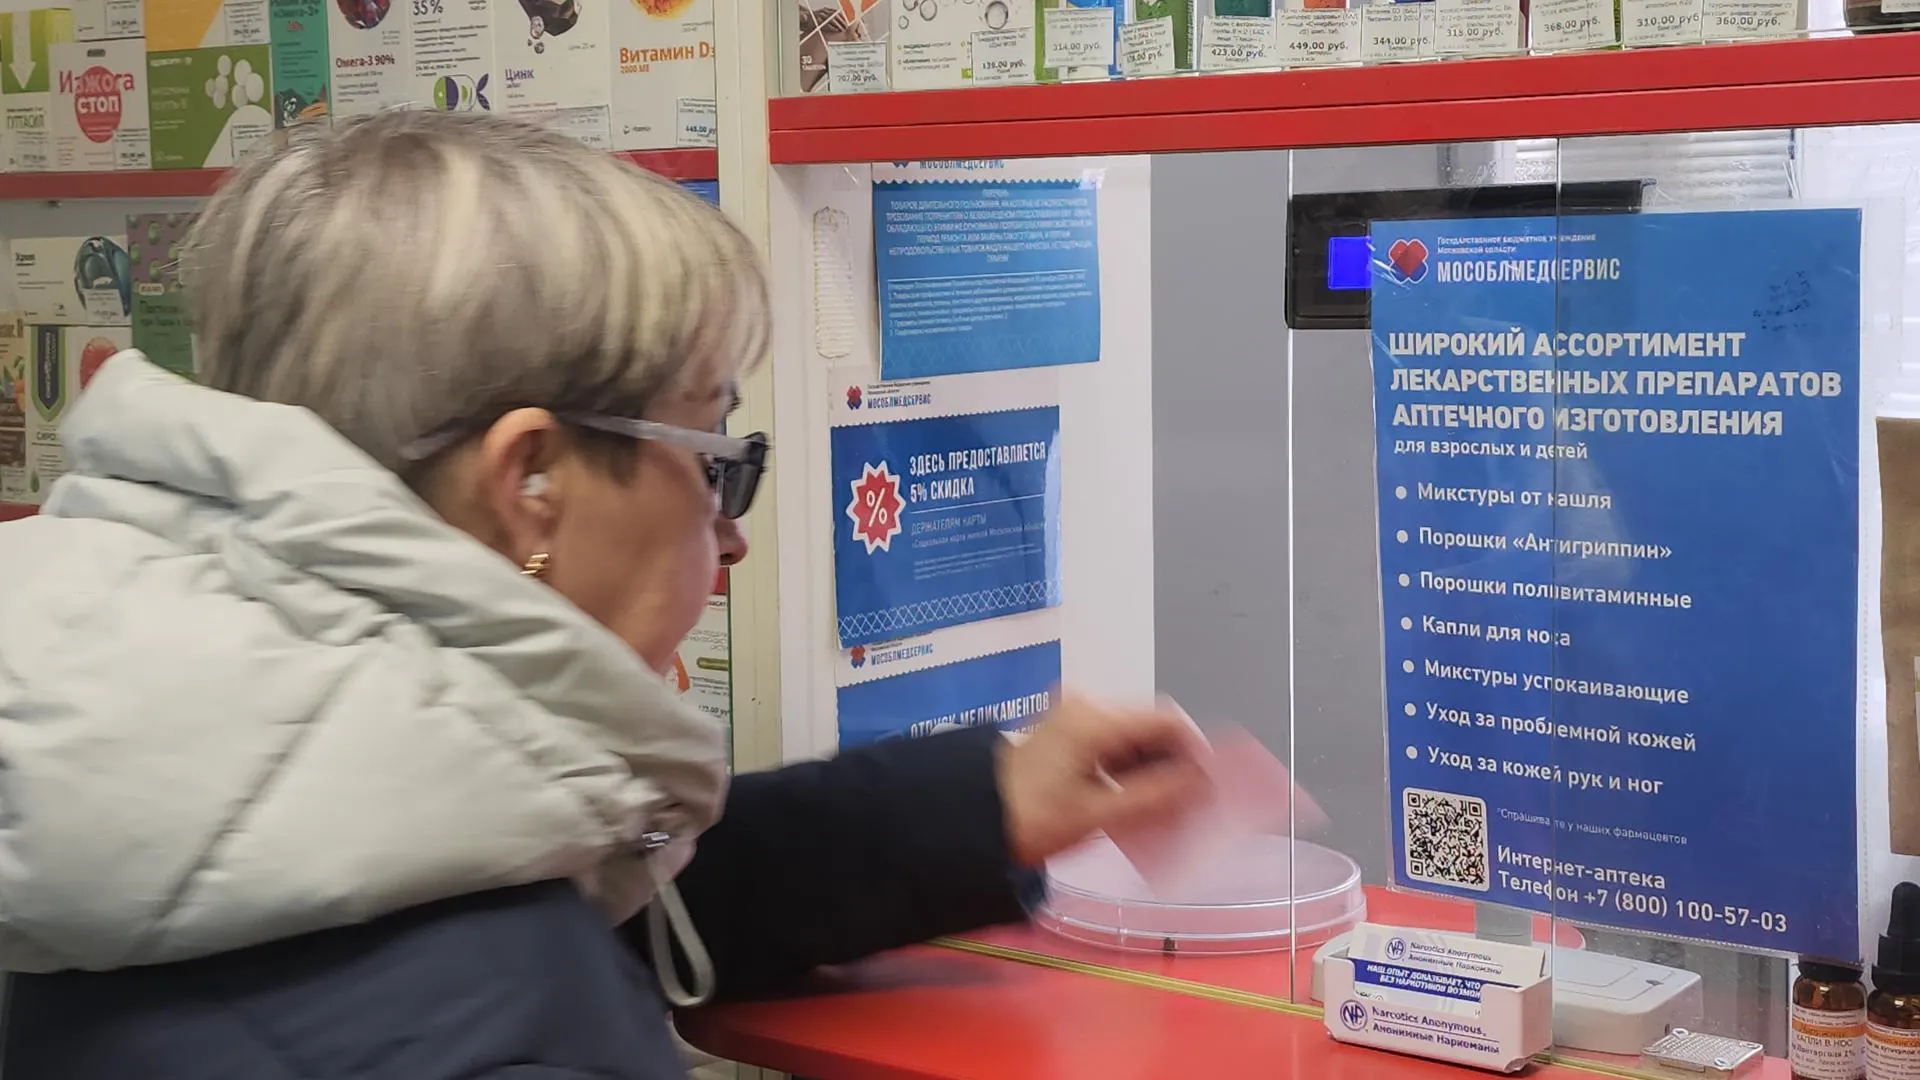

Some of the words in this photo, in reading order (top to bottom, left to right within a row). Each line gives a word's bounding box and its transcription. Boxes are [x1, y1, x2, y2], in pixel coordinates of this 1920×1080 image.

[1636, 15, 1675, 27] 310.00
[1716, 16, 1754, 26] 360.00
[1757, 16, 1781, 28] руб.
[620, 46, 694, 64] Витамин
[1211, 48, 1243, 57] 423.00
[1289, 41, 1325, 50] 449.00
[1328, 41, 1349, 52] руб.
[505, 68, 534, 82] Цинк
[1437, 258, 1620, 284] МОСОБЛМЕДСЕРВИС
[1389, 326, 1525, 357] ШИРОКИЙ
[1532, 332, 1746, 357] АССОРТИМЕНТ
[1390, 368, 1628, 395] ЛЕКАРСТВЕННЫХ
[1636, 371, 1842, 397] ПРЕПАРАТОВ
[867, 393, 932, 409] МОСОБЛМЕДСЕРВИС
[1392, 404, 1545, 430] АПТЕЧНОГО
[1553, 408, 1783, 436] ИЗГОТОВЛЕНИЯ
[909, 453, 944, 477] ЗДЕСЬ
[949, 441, 1046, 471] ПРЕДОСТАВЛЯЕТСЯ
[1394, 440, 1425, 455] для
[1430, 441, 1516, 460] взрослых
[1520, 444, 1531, 457] и
[1535, 442, 1588, 460] детей
[910, 484, 928, 502] 5%
[930, 477, 975, 501] СКИДКА
[1417, 482, 1515, 506] Микстуры
[1520, 490, 1543, 506] от
[1419, 526, 1506, 550] Порошки
[1419, 571, 1506, 594] Порошки
[1512, 584, 1692, 609] поливитаминные
[1422, 616, 1481, 638] Капли
[1486, 624, 1521, 642] для
[1424, 658, 1518, 688] Микстуры
[1523, 673, 1690, 704] успокаивающие
[1425, 702, 1471, 728] Уход
[1475, 712, 1495, 728] за
[1501, 715, 1621, 745] проблемной
[1627, 733, 1697, 752] кожей
[1426, 745, 1473, 772] Уход
[1477, 756, 1497, 773] за
[1502, 760, 1561, 783] кожей
[1567, 770, 1604, 789] рук
[1608, 775, 1621, 790] и
[1627, 778, 1664, 795] ног
[1576, 823, 1612, 836] наших
[1497, 844, 1666, 890] Интернет-аптека
[1496, 870, 1579, 903] Телефон
[1583, 889, 1608, 908] +7
[1614, 892, 1668, 918] (800)
[1676, 899, 1788, 933] 100-57-03
[1410, 942, 1445, 954] Narcotics
[1380, 974, 1395, 983] БЕЗ
[1395, 977, 1446, 993] НАРКОТИКОВ
[1387, 967, 1410, 977] ОПЫТ
[1464, 980, 1481, 990] ЧТО
[1372, 1006, 1419, 1024] Narcotics
[1373, 1023, 1434, 1043] Анонимные
[1436, 1034, 1499, 1054] Наркоманы
[1833, 1039, 1853, 1048] НОС
